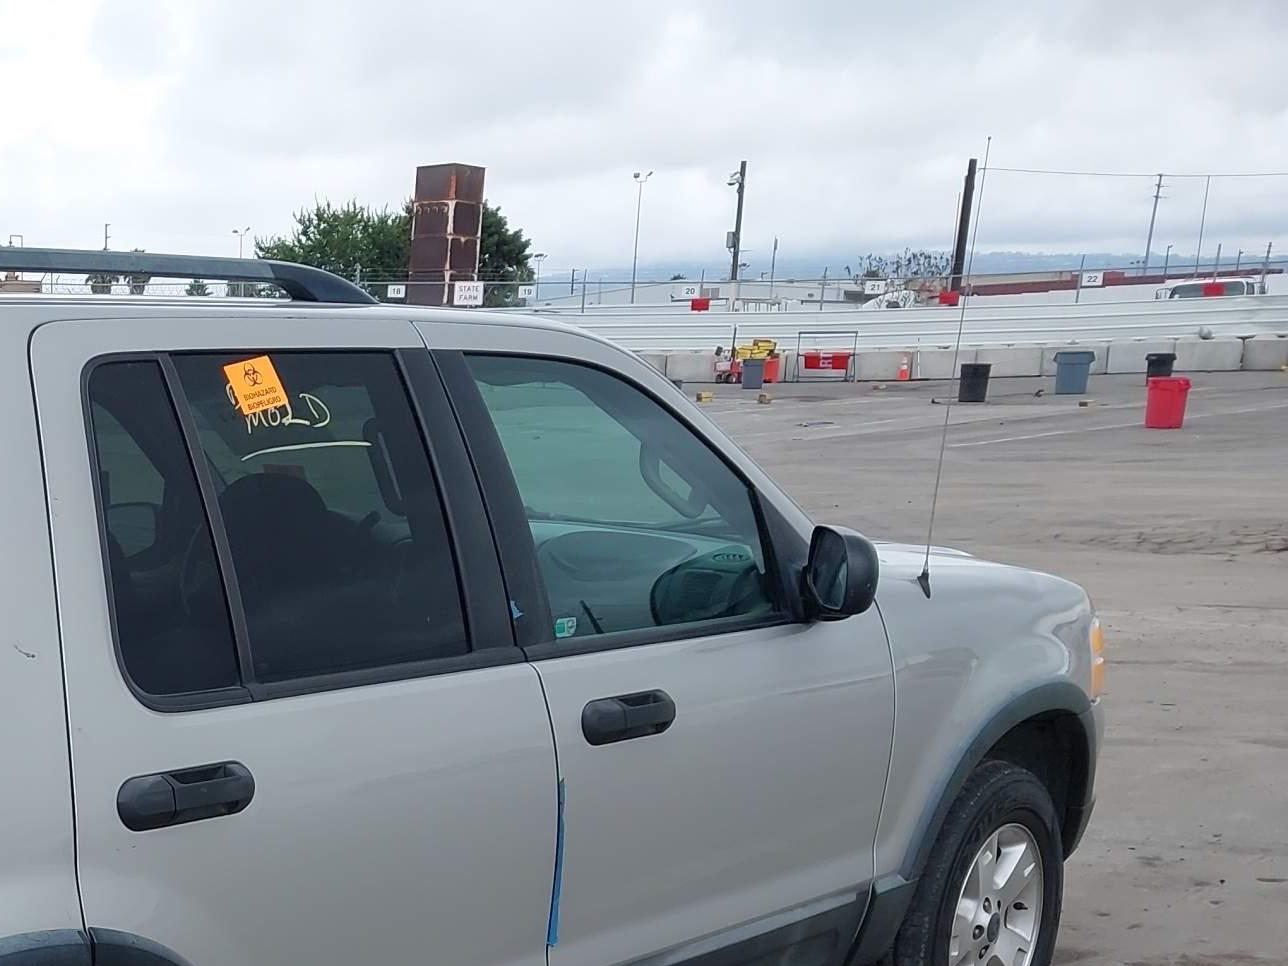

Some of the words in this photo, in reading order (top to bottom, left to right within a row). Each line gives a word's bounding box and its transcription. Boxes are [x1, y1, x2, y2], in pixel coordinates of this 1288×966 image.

[1087, 275, 1098, 283] 22
[458, 285, 480, 293] STATE
[523, 288, 532, 296] 19
[684, 287, 696, 295] 20
[458, 294, 479, 302] FARM
[243, 386, 277, 401] BIOHAZARD
[248, 395, 282, 411] BIOPELIGRO
